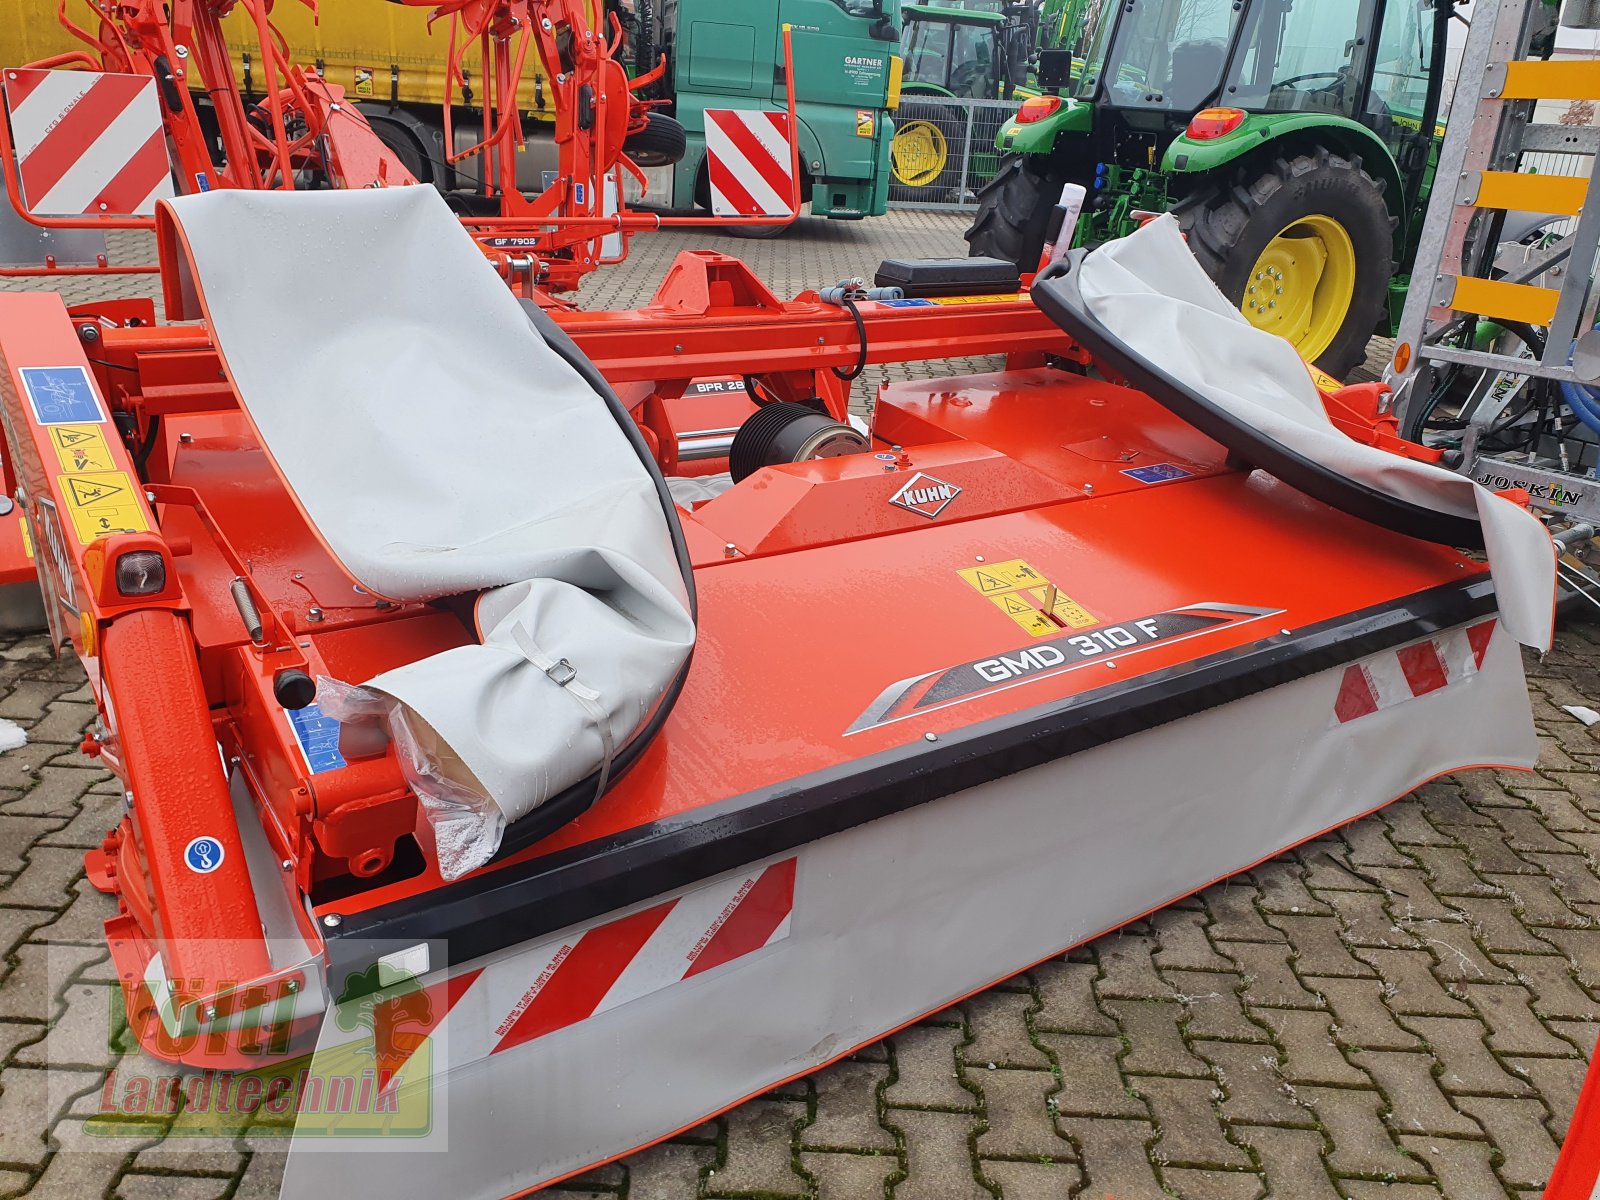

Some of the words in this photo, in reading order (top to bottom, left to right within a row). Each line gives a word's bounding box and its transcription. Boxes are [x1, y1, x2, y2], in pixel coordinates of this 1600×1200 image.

[844, 56, 882, 67] GARTNER
[1400, 118, 1418, 129] JOHN
[494, 238, 508, 246] GF
[510, 237, 536, 245] 7902
[696, 382, 725, 393] BPR
[902, 484, 953, 506] KUHN
[1477, 474, 1583, 505] JOSKIN
[43, 504, 74, 607] KUHN
[973, 645, 1065, 683] GMD
[1068, 626, 1138, 656] 310
[1134, 618, 1159, 639] F
